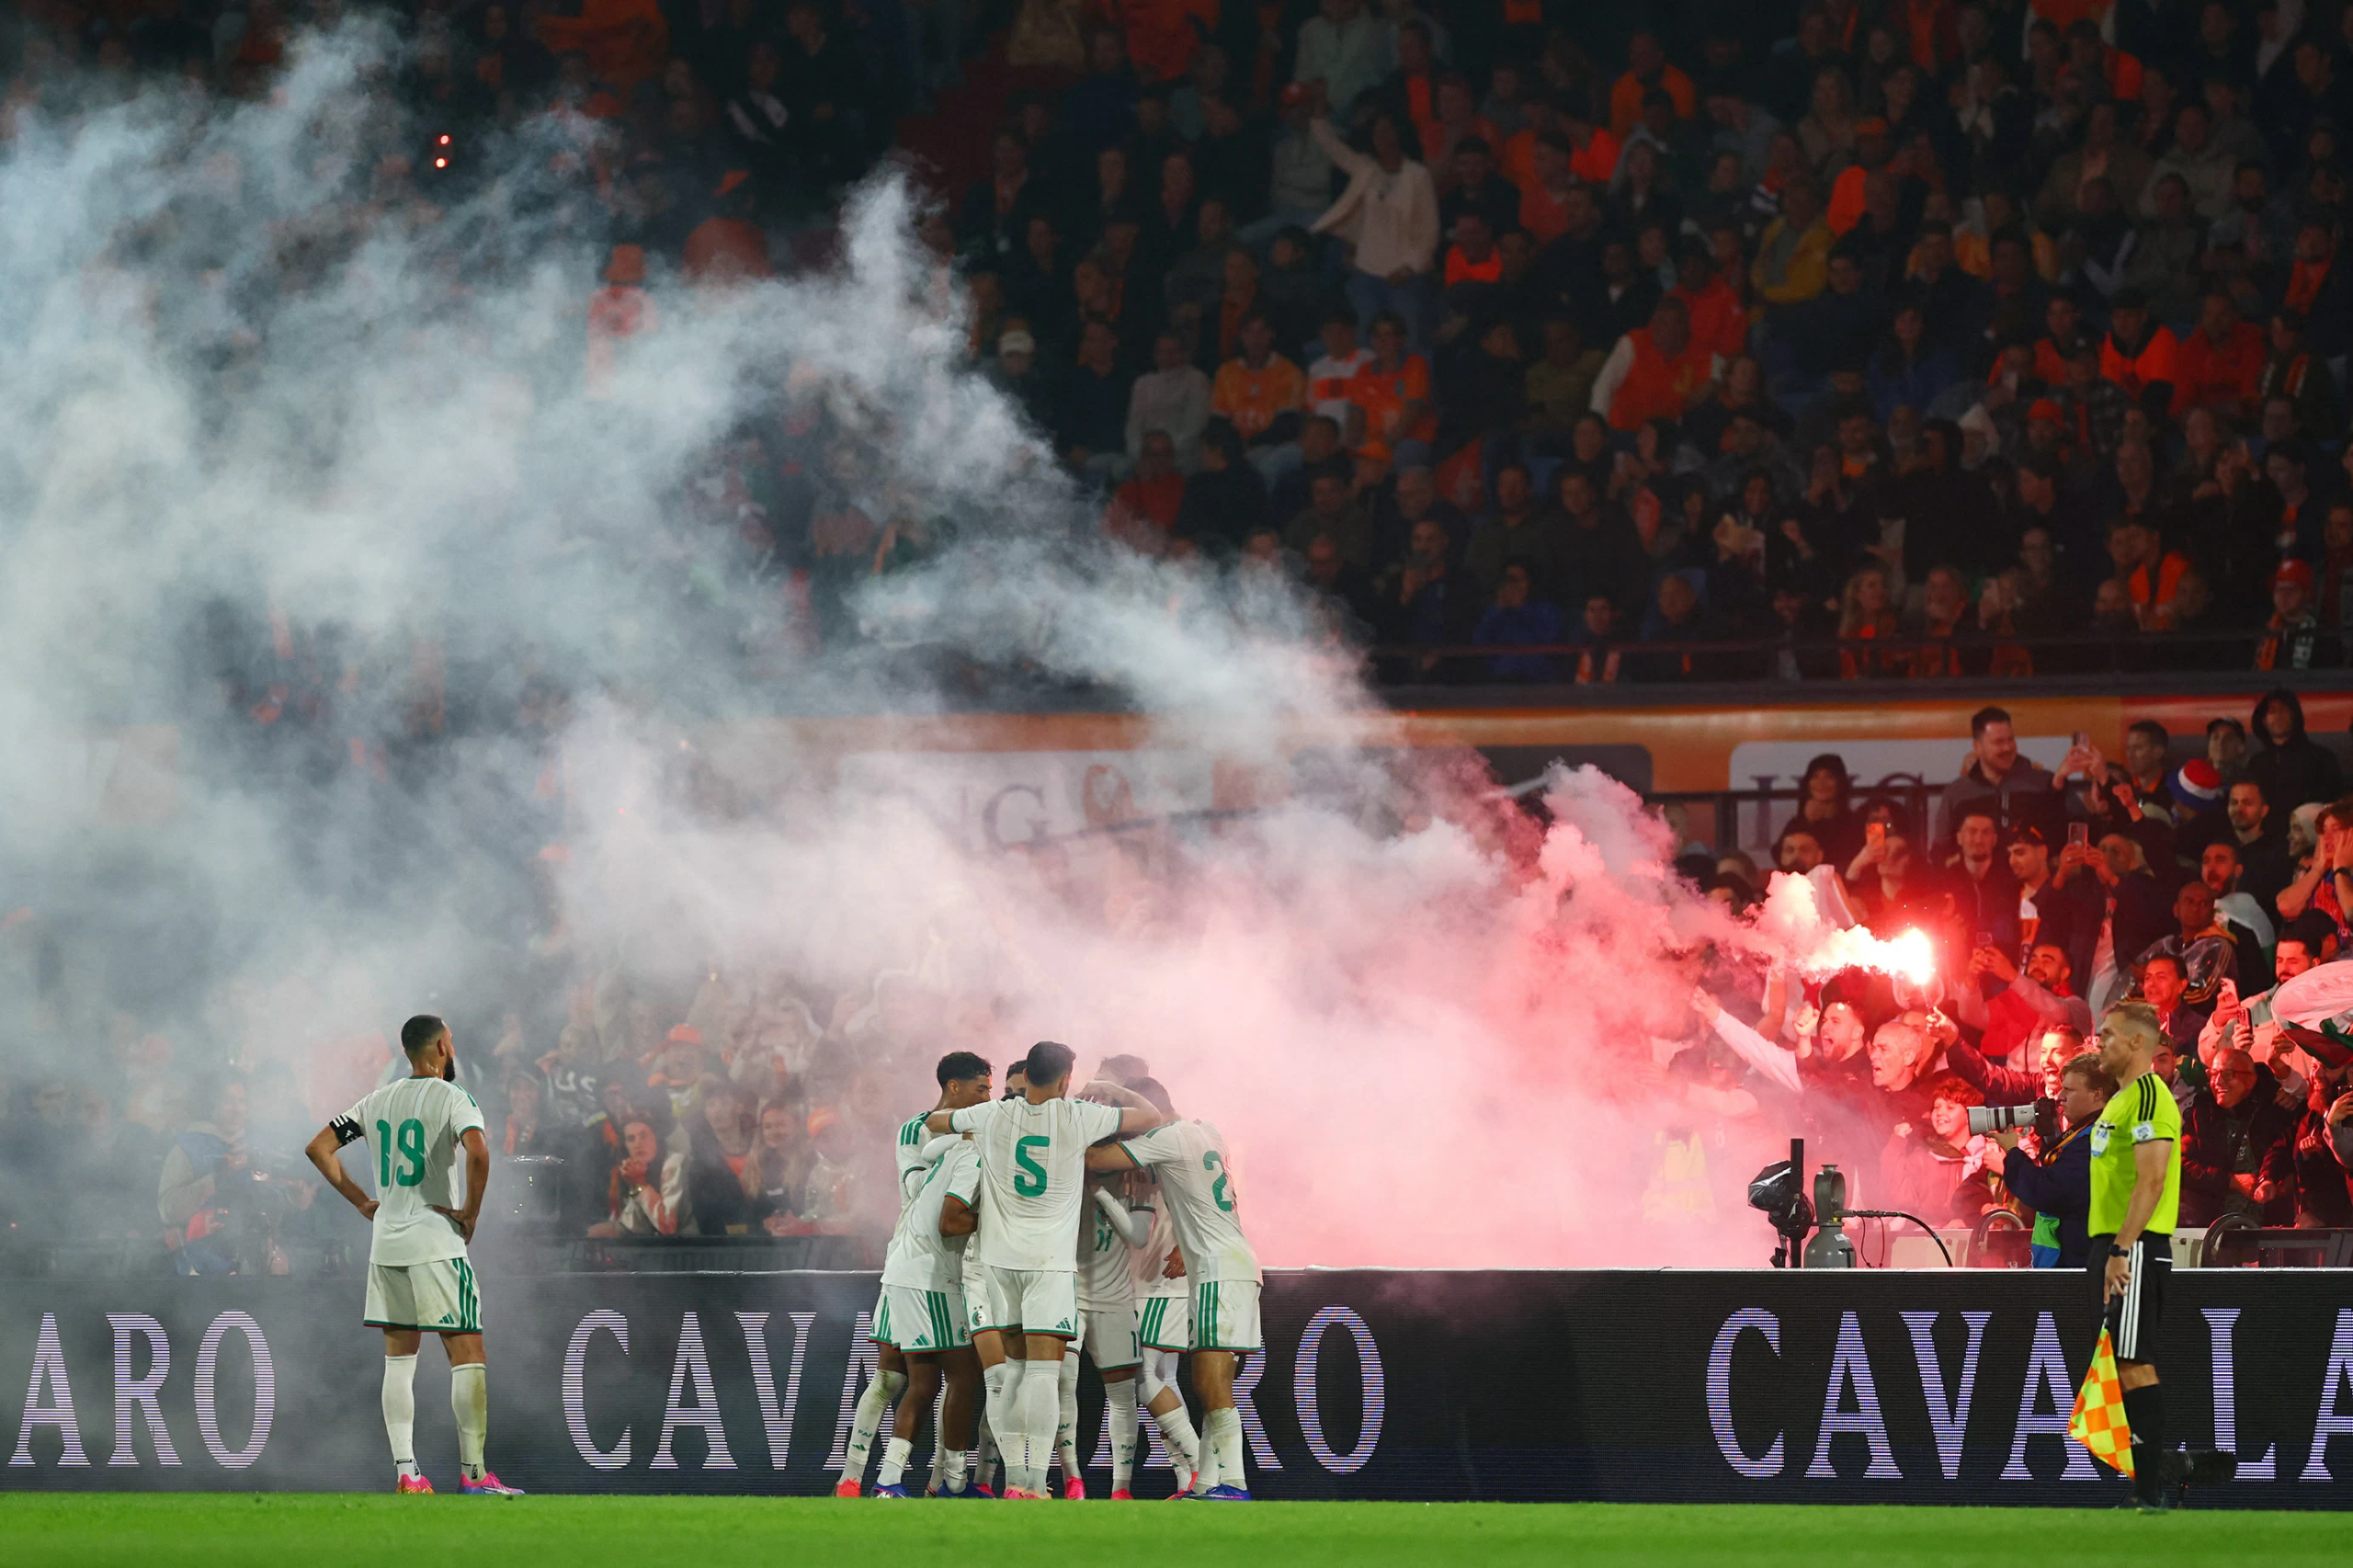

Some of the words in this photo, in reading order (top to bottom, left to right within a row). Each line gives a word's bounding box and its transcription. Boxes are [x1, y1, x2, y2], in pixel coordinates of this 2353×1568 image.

[376, 1118, 426, 1187] 19
[1014, 1135, 1051, 1198] 5
[7, 1309, 276, 1470] ARO
[1705, 1306, 2353, 1483] CAVALA
